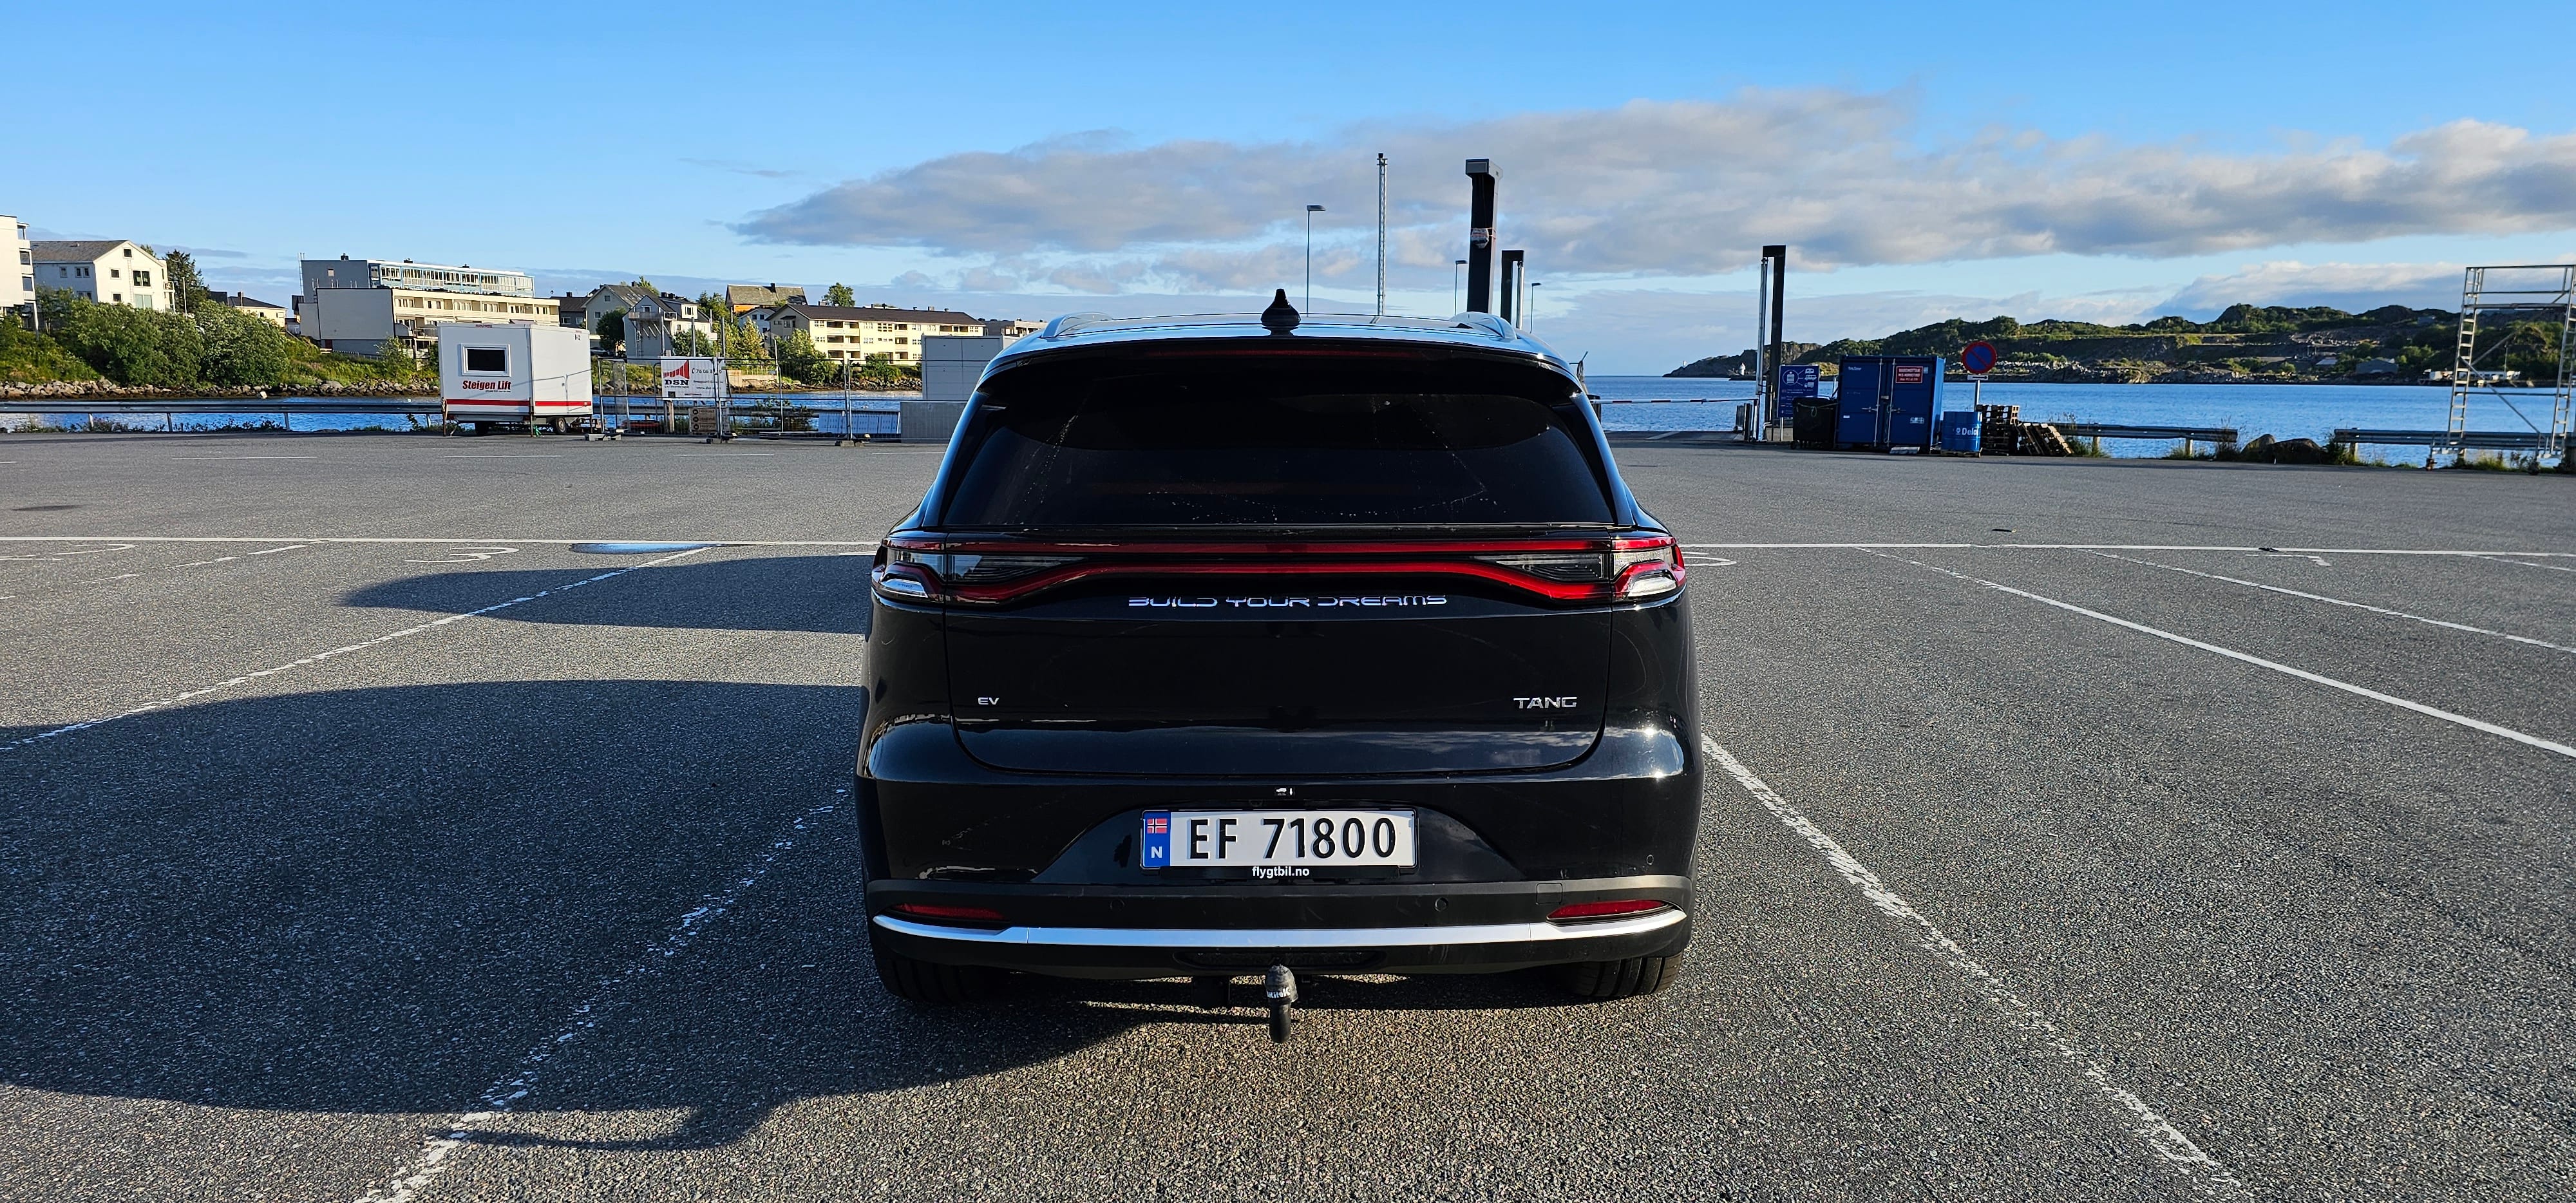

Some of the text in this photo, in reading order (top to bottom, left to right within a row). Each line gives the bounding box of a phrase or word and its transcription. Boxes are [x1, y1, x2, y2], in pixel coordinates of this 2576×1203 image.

[462, 380, 511, 390] Steigen Lift
[1128, 595, 1447, 607] BUILD YOUR DREAMS
[978, 697, 999, 705] EV
[1513, 696, 1577, 709] TANG
[1189, 817, 1396, 860] EF 71800
[1151, 846, 1162, 858] N
[1251, 866, 1311, 879] flygtbil.no
